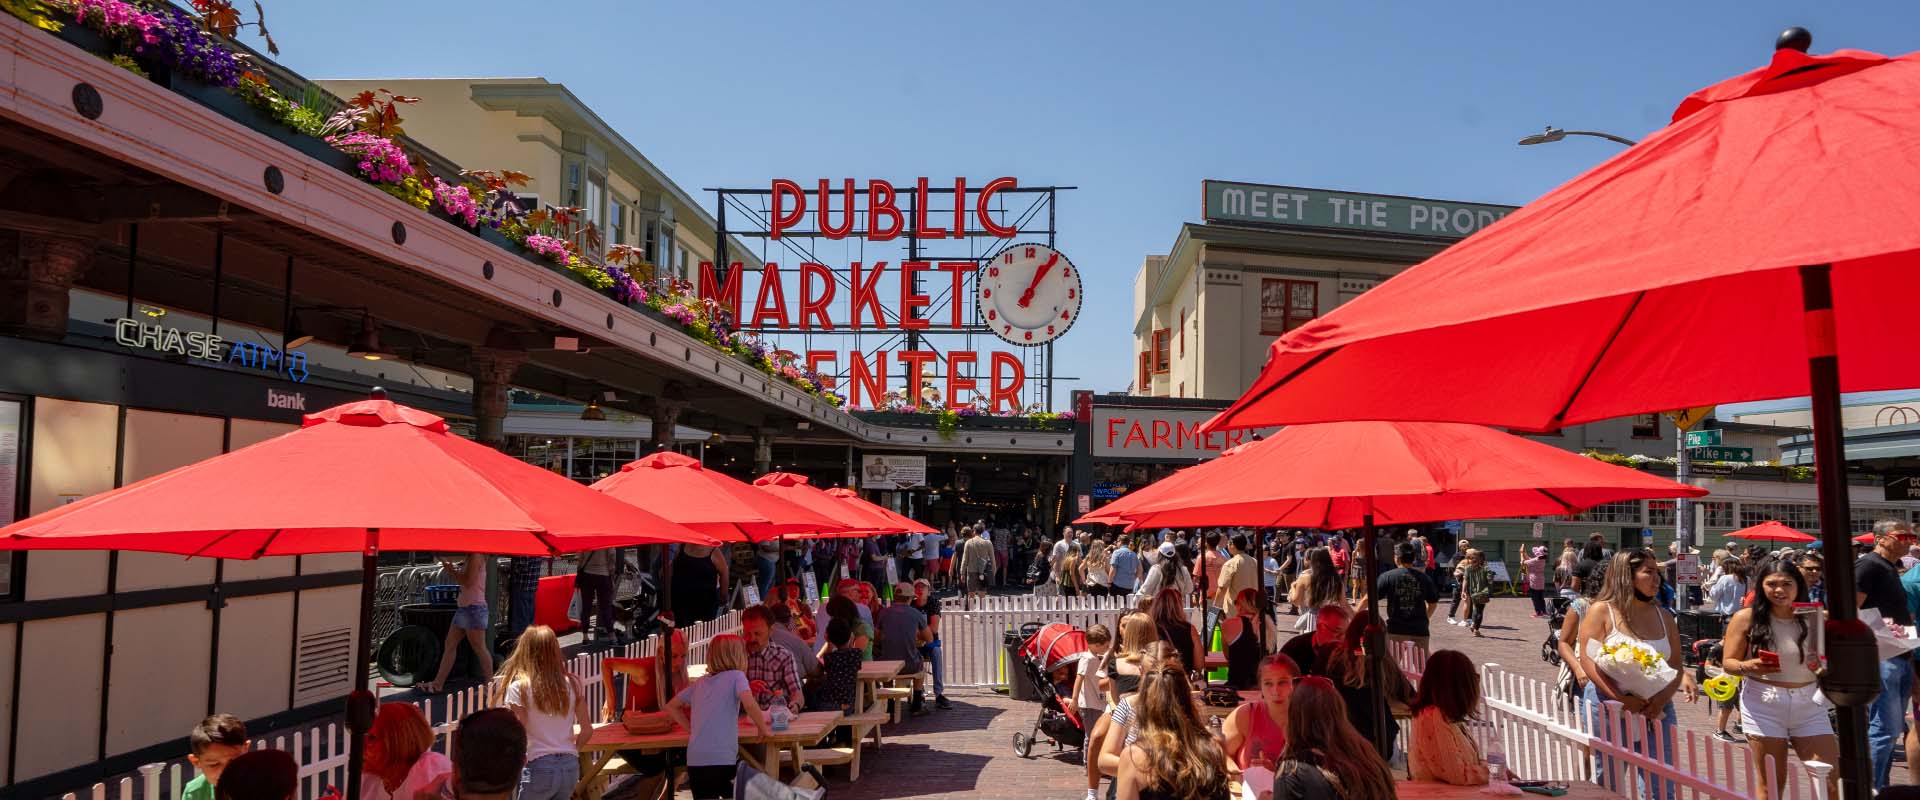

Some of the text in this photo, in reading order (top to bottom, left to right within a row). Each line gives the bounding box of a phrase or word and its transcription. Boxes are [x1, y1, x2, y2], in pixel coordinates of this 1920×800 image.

[770, 176, 1018, 241] PUBLIC
[1221, 187, 1505, 234] MEET THE PROD
[1004, 253, 1013, 264] 11
[1025, 247, 1036, 259] 12
[989, 267, 999, 278] 10
[1063, 267, 1070, 278] 2
[698, 261, 979, 330] MARKET
[983, 288, 991, 299] 9
[1068, 288, 1075, 299] 3
[988, 309, 996, 320] 8
[1060, 310, 1069, 320] 4
[1004, 326, 1012, 334] 7
[1048, 326, 1054, 334] 5
[1024, 331, 1032, 341] 6
[115, 317, 284, 374] CHASE ATM
[267, 388, 306, 411] bank
[1696, 448, 1719, 458] Pike
